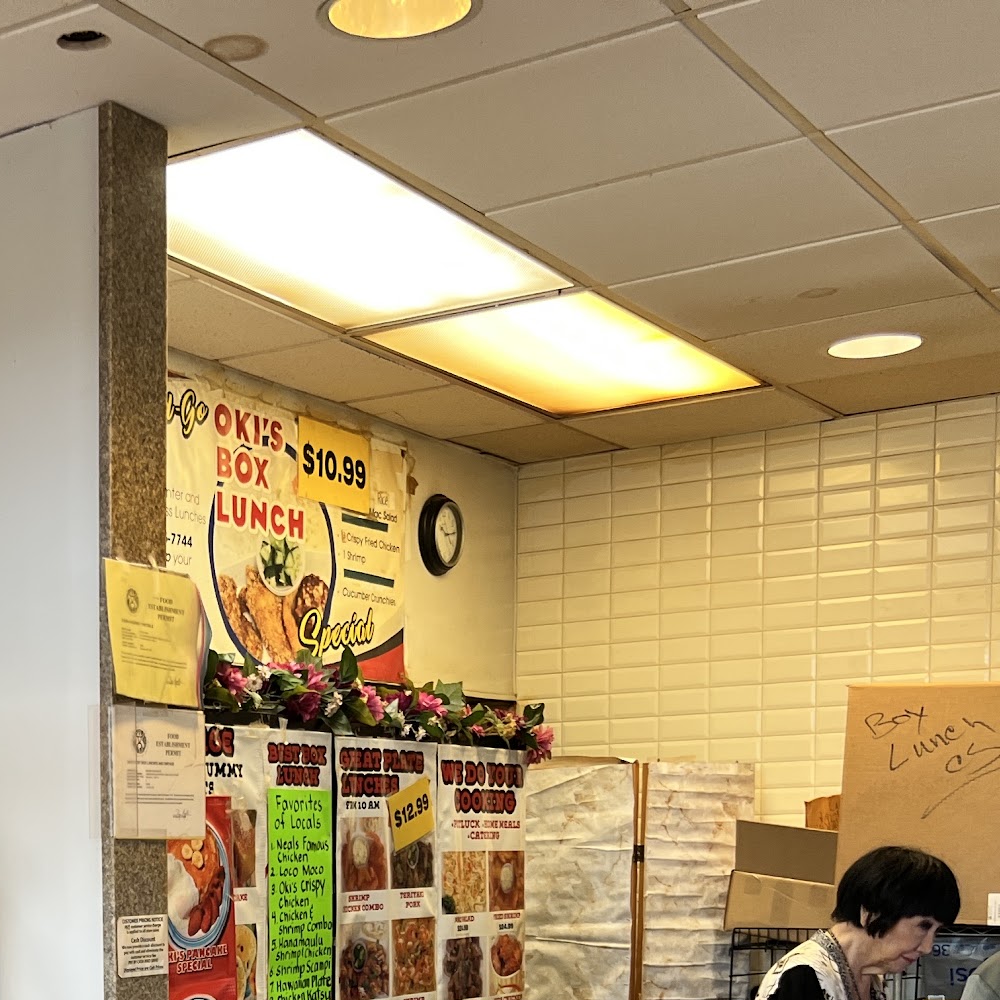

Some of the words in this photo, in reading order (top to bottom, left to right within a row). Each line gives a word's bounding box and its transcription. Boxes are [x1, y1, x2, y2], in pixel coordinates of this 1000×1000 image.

[214, 403, 284, 452] OKI'S
[216, 446, 269, 490] BOX
[302, 441, 366, 490] $10.99
[185, 493, 200, 505] and
[174, 506, 207, 526] Lunches
[216, 491, 304, 541] LUNCH
[346, 532, 363, 546] Crispy
[365, 537, 378, 549] Fried
[379, 540, 400, 553] Chicken
[173, 554, 193, 567] your
[347, 551, 366, 565] Shrimp
[343, 587, 370, 602] Cucumber
[299, 607, 375, 657] Special
[865, 706, 928, 739] Box
[465, 761, 485, 786] DO
[275, 794, 323, 813] Favorites
[394, 794, 429, 828] $12.99
[274, 812, 285, 829] of
[290, 813, 321, 829] Locals
[276, 838, 299, 851] Neals
[302, 836, 329, 852] Famous
[278, 850, 308, 863] Chicken
[279, 866, 298, 877] Loco
[302, 865, 324, 877] Moco
[177, 958, 212, 974] SPECIAL
